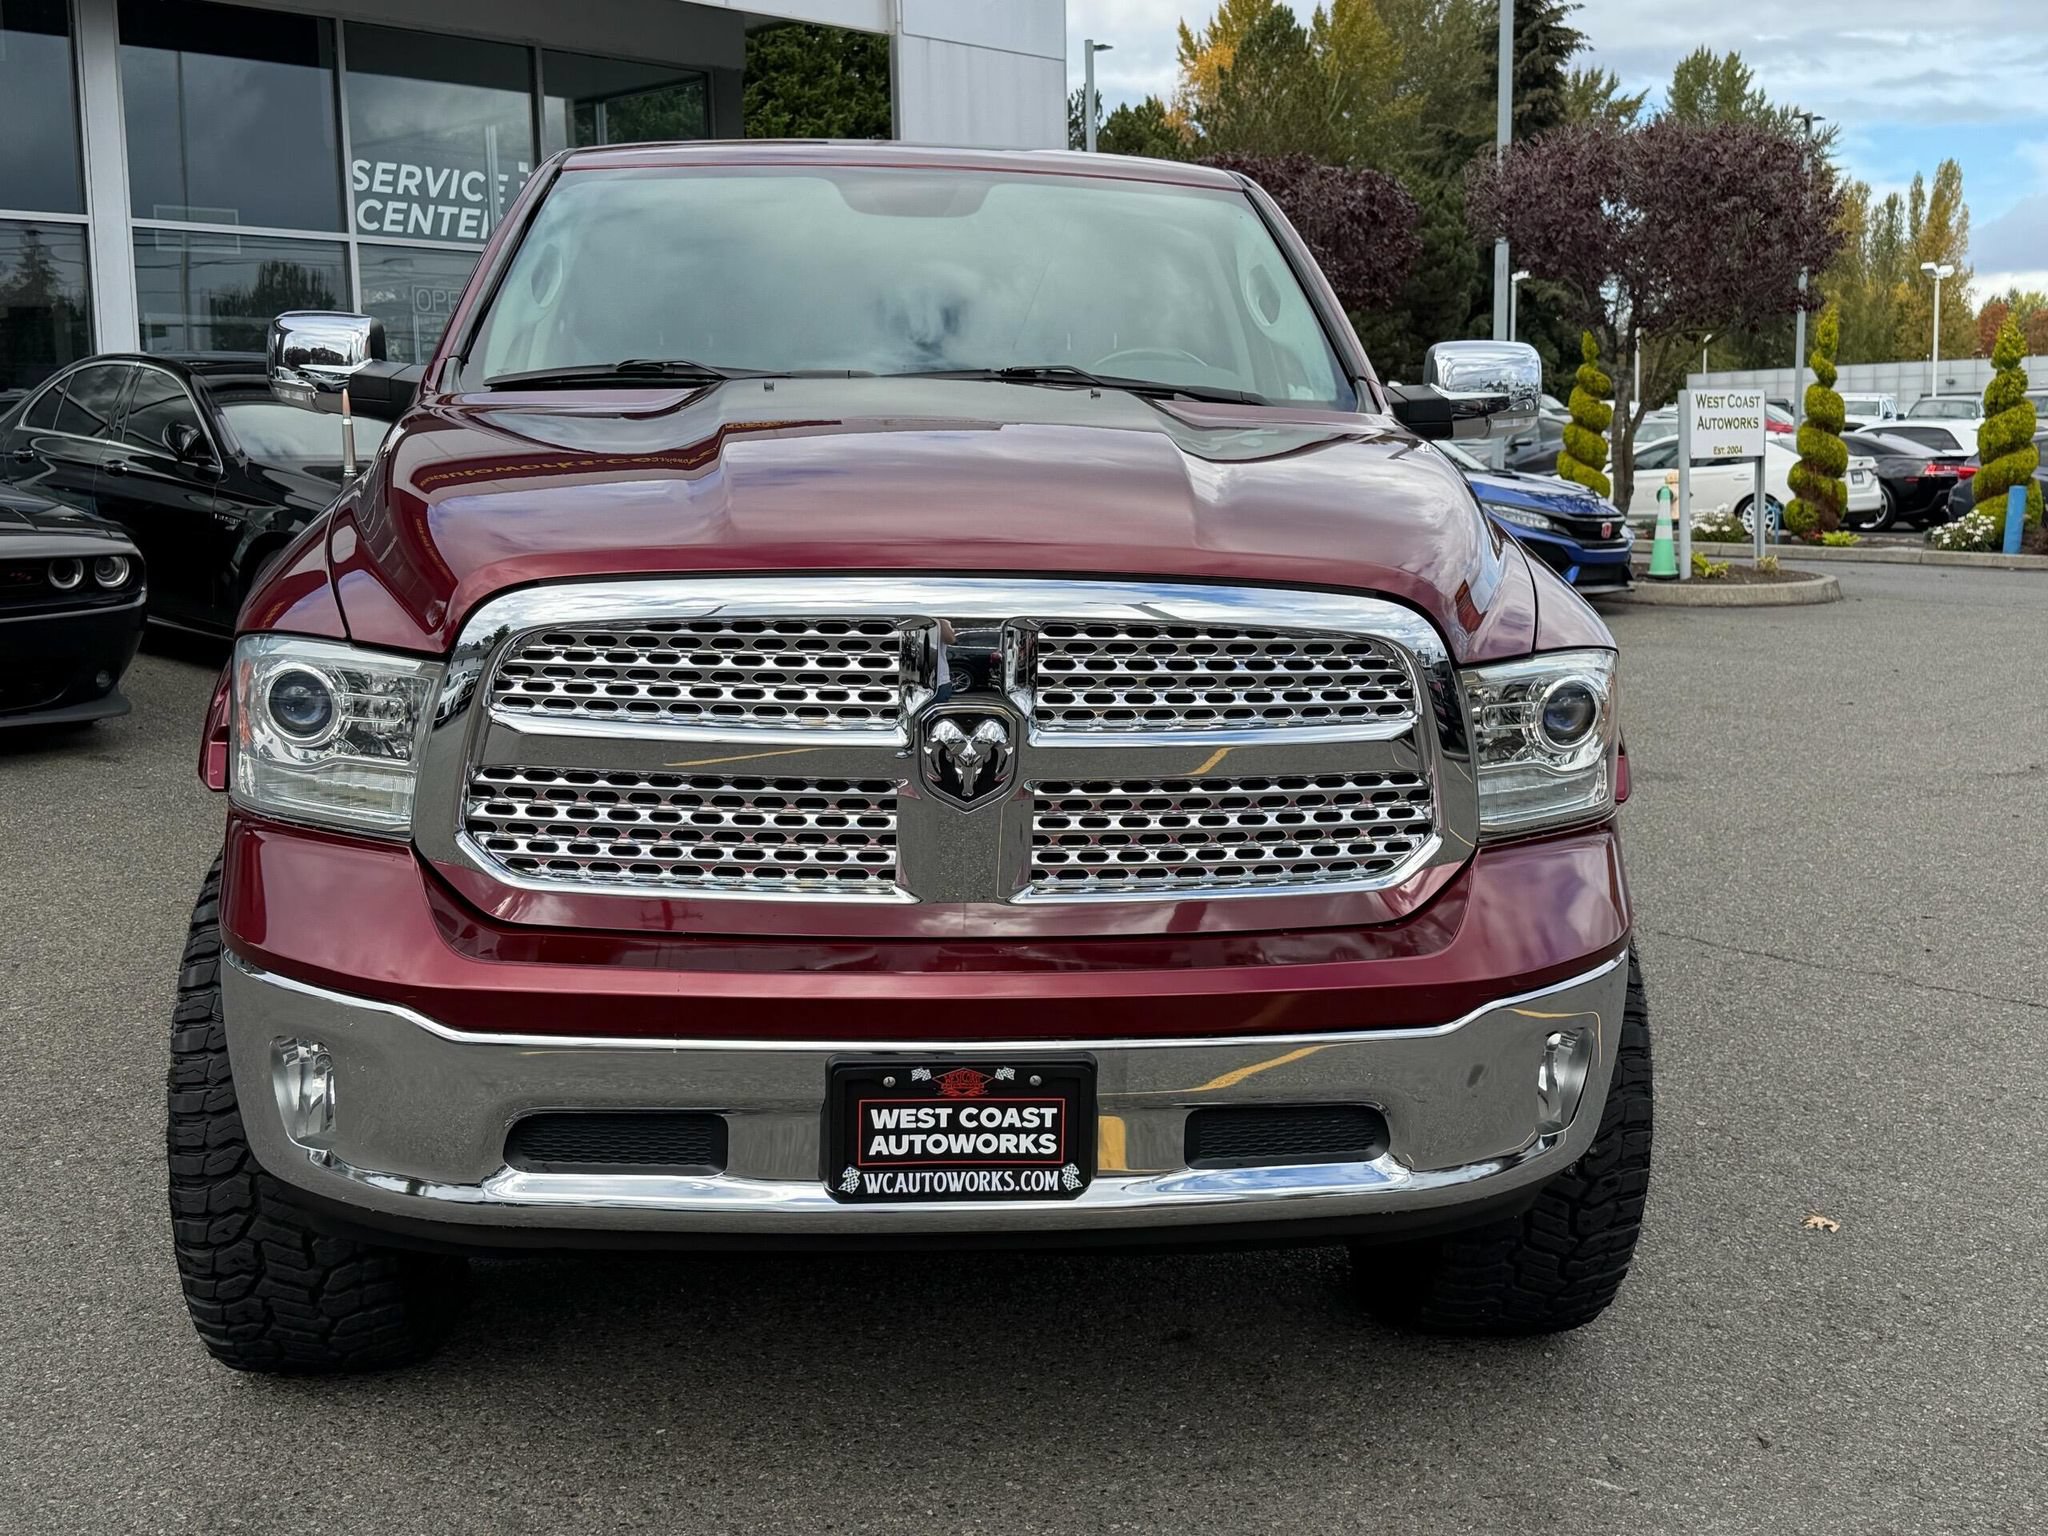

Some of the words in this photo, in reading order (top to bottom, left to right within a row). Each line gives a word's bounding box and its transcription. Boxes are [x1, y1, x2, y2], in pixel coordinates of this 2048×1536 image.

[416, 289, 460, 312] OPE
[1696, 394, 1725, 408] WEST
[1727, 394, 1760, 408] COAST
[1697, 416, 1759, 430] AUTOWORKS
[1727, 445, 1742, 454] 2004
[870, 1107, 953, 1130] WEST
[958, 1106, 1058, 1129] COAST
[868, 1133, 1058, 1156] AUTOWORKS
[863, 1170, 1060, 1194] WCAUTOWORKS.COM
